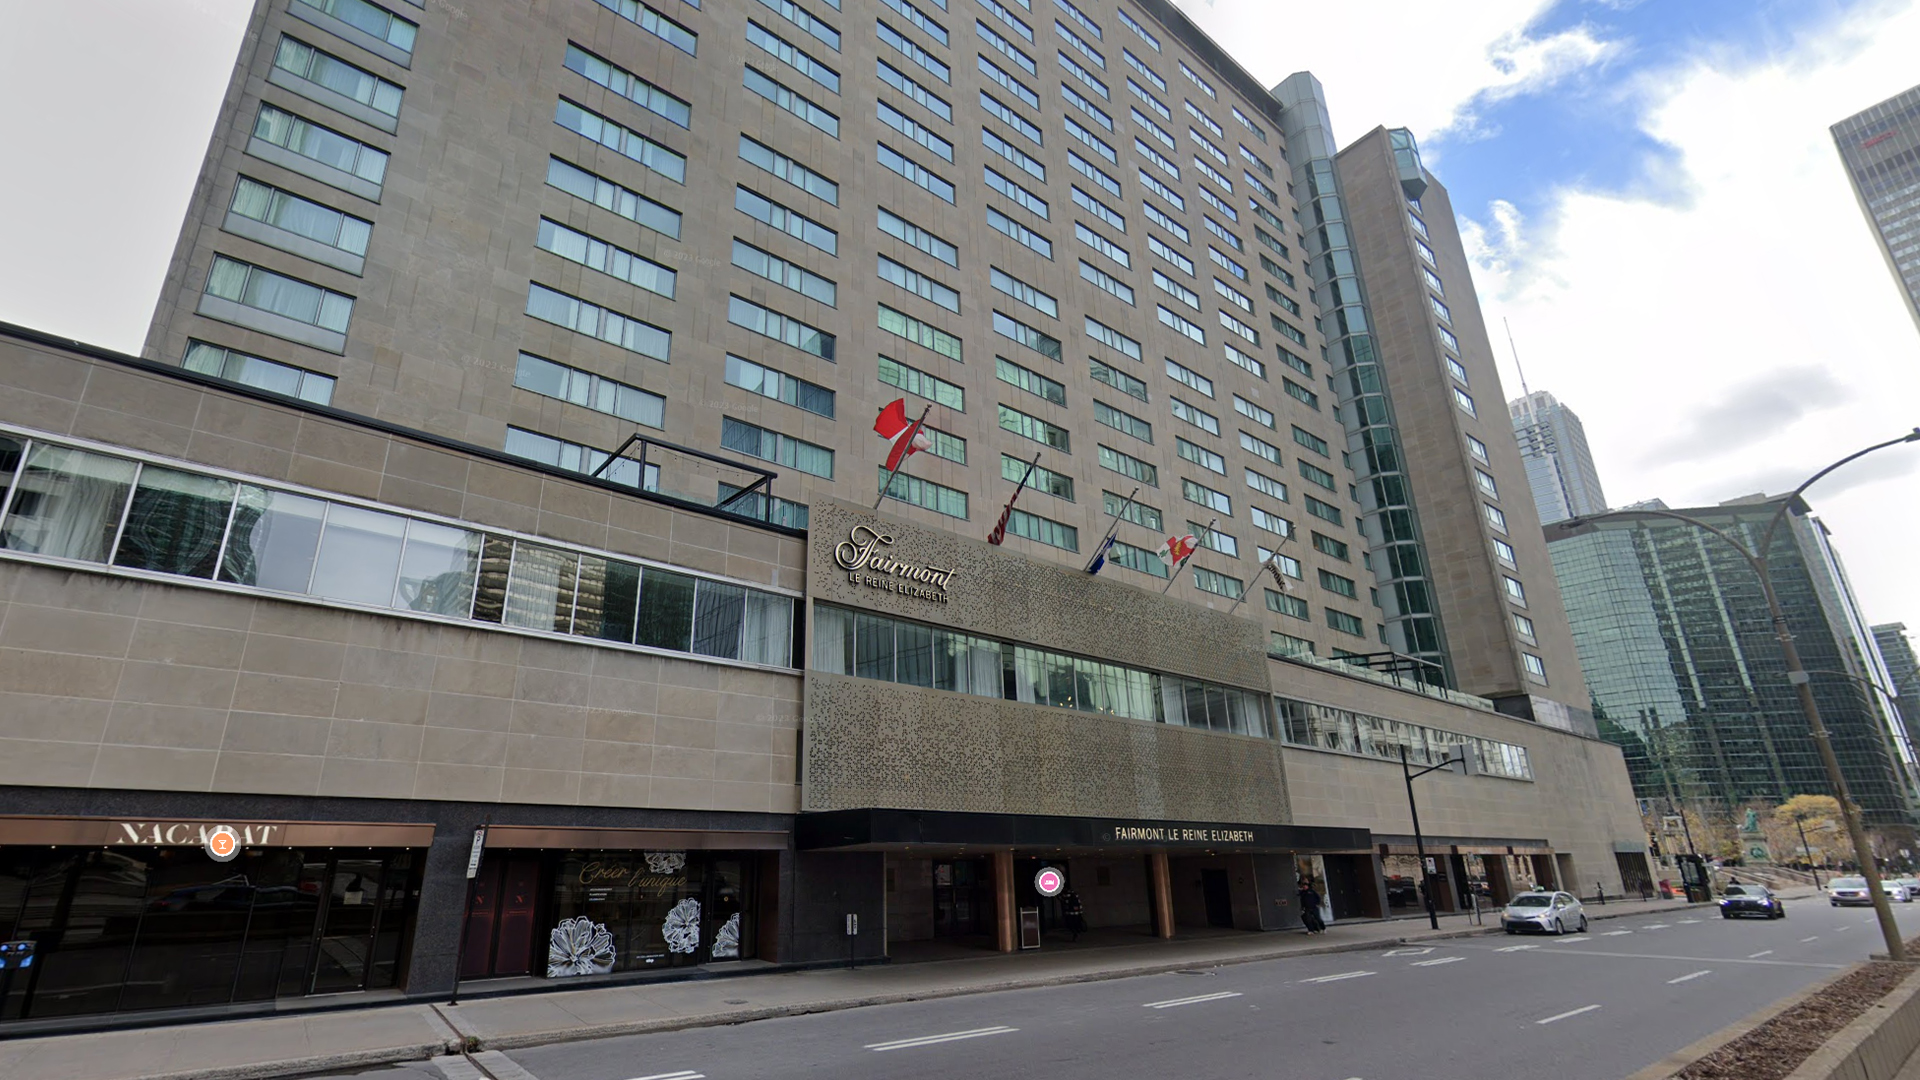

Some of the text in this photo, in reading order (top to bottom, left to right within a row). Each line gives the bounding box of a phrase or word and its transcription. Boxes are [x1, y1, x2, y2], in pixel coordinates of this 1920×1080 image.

[834, 525, 957, 591] Fairmont
[848, 572, 949, 603] LE REINE ELIZABETH
[1115, 827, 1254, 842] FAIRMONT LE REINE ELIZABETH
[579, 861, 630, 885] Créer
